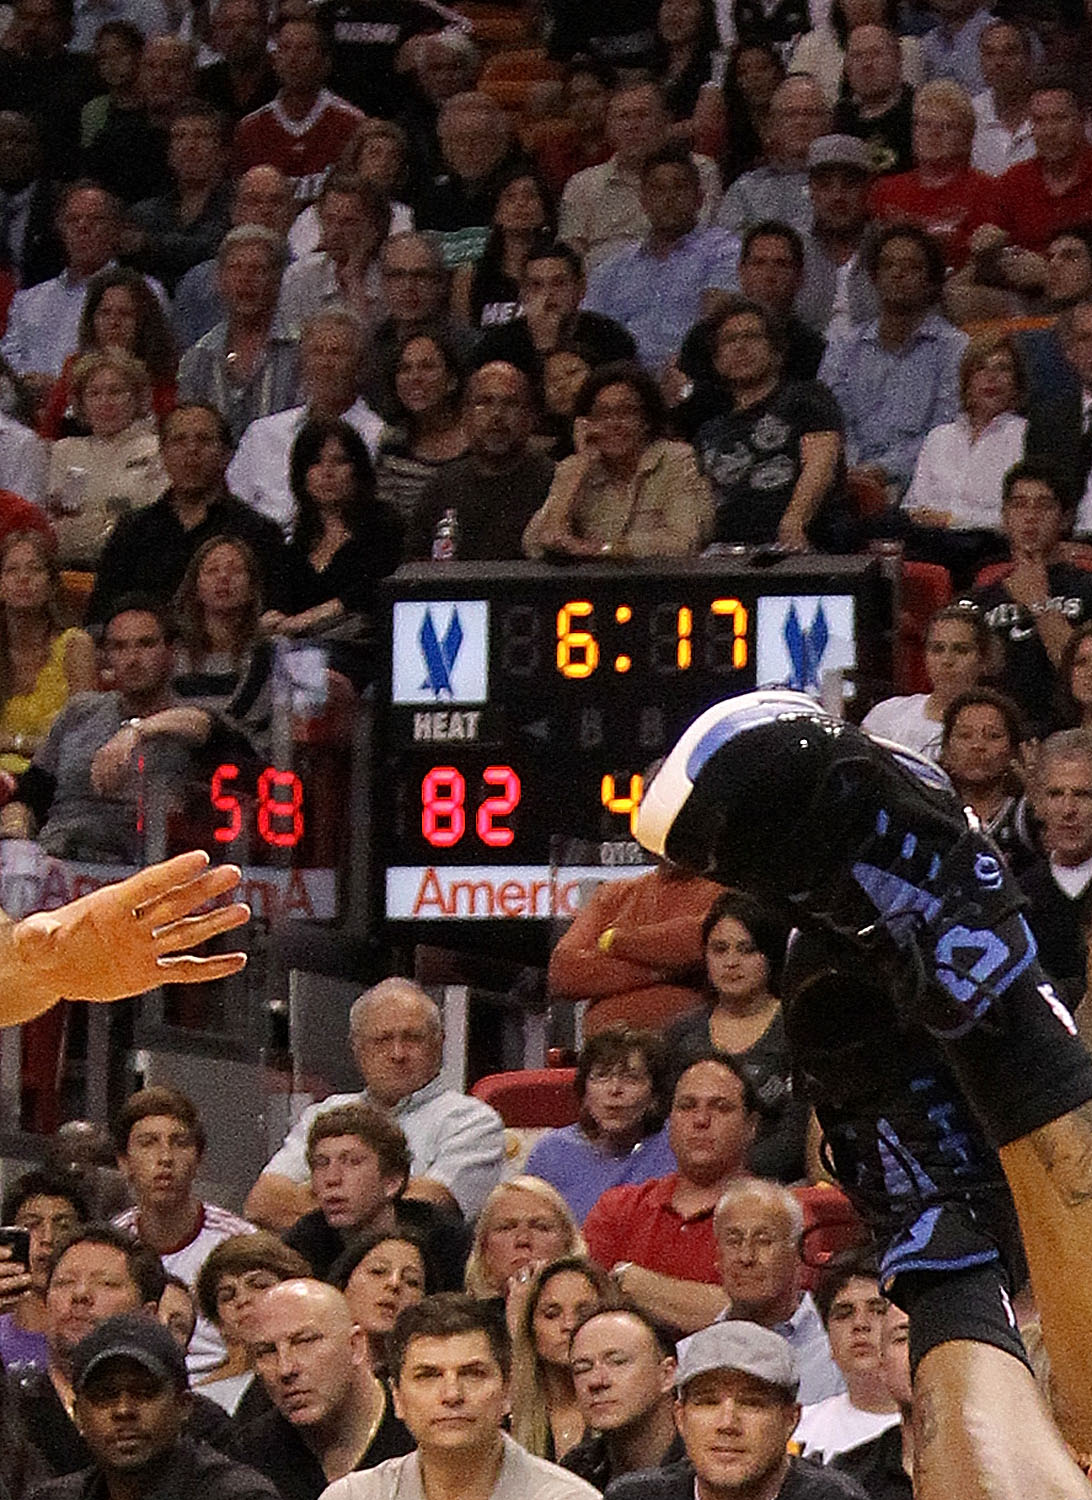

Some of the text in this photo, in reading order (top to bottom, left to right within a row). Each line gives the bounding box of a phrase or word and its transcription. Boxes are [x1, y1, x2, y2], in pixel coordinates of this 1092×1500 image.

[557, 599, 748, 678] 6:17
[413, 711, 480, 741] HEAT
[422, 766, 521, 847] 82
[601, 774, 643, 838] 4
